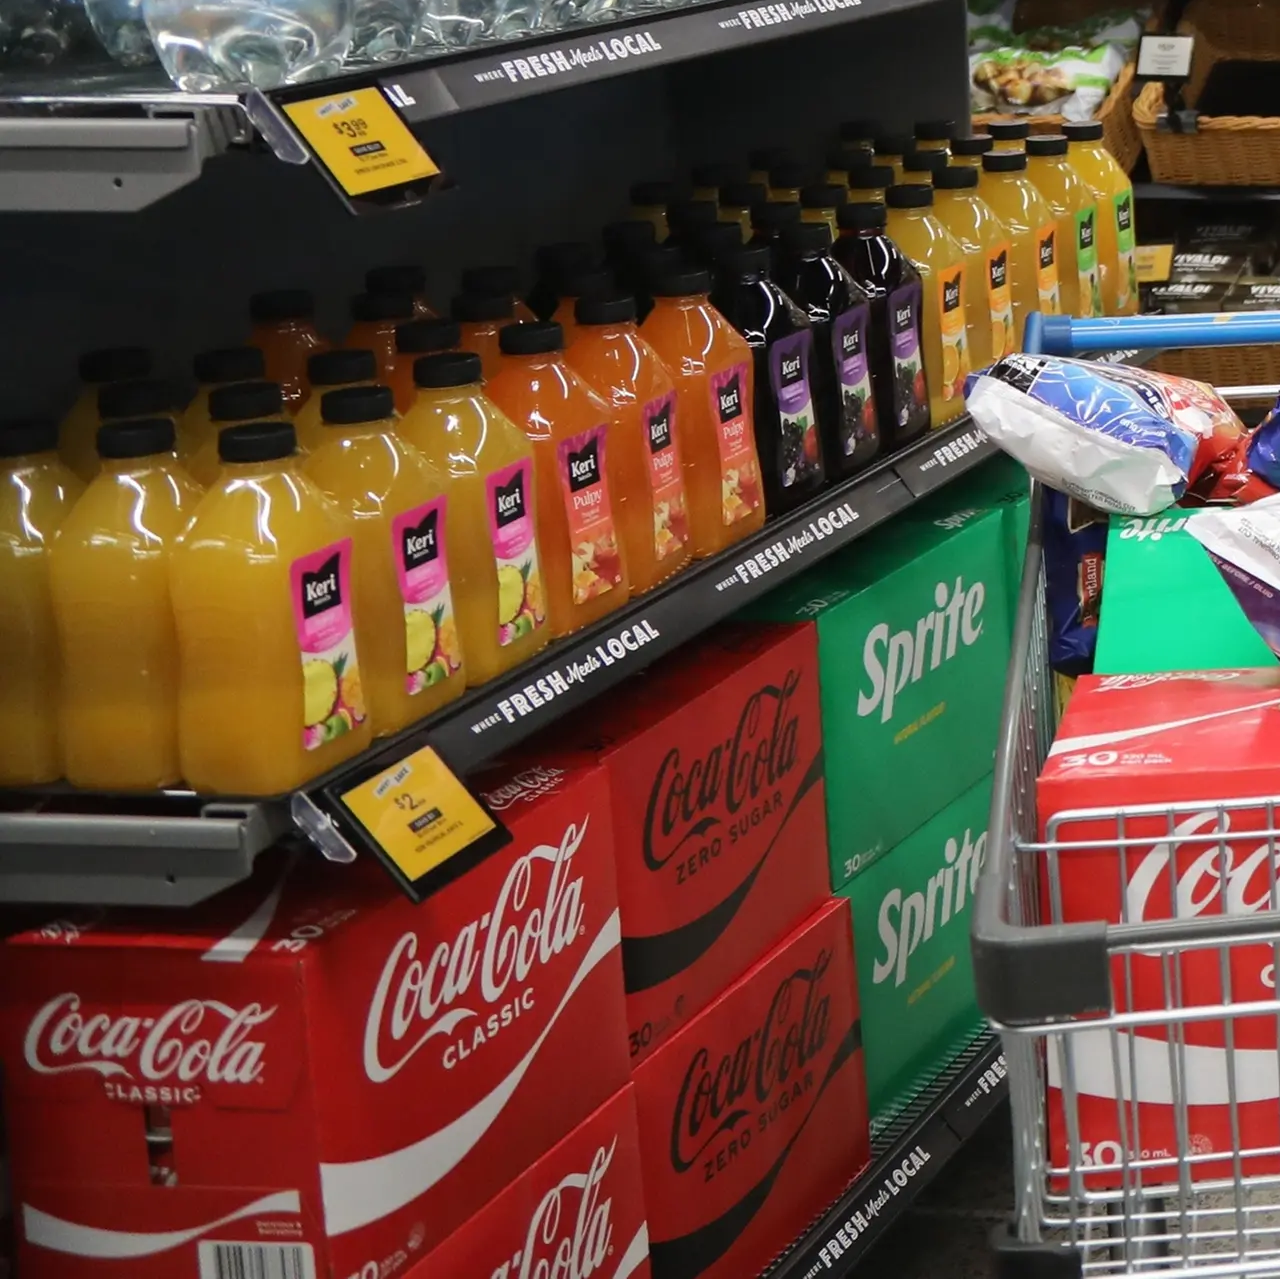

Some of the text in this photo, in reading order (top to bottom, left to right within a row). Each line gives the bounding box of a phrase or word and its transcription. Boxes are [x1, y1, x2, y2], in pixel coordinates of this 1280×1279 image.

[738, 2, 793, 30] FRESH
[474, 30, 662, 84] WHERE FRESH Meets LOCAL
[945, 285, 959, 300] Keri
[895, 306, 911, 324] Keri
[842, 329, 859, 348] Keri
[781, 355, 801, 374] Keri
[719, 389, 739, 410] Keri
[651, 418, 669, 439] Keri
[723, 421, 745, 439] Pulpy
[654, 451, 675, 470] Pulpy
[934, 432, 977, 467] FRESH
[572, 454, 596, 478] Keri
[497, 487, 521, 513] Keri
[571, 488, 602, 510] Pulpy
[406, 528, 436, 556] Keri
[715, 502, 860, 592] WHERE FRESH Meets LOCAL
[305, 572, 337, 602] Keri
[856, 575, 985, 725] Sprite
[471, 619, 660, 735] WHERE FRESH Meets LOCAL
[641, 669, 801, 872] Coca-Cola
[1059, 749, 1118, 770] 30
[675, 792, 785, 886] ZERO SUGAR
[843, 852, 861, 879] 30
[363, 811, 591, 1084] Coca-Cola
[23, 991, 280, 1085] Coca-Cola
[441, 987, 536, 1071] CLASSIC
[628, 1019, 654, 1058] 30
[670, 949, 833, 1174] Coca-Cola
[104, 1082, 202, 1105] CLASSIC
[703, 1072, 815, 1183] ZERO SUGAR
[818, 1145, 932, 1270] FRESH Meets LOCAL
